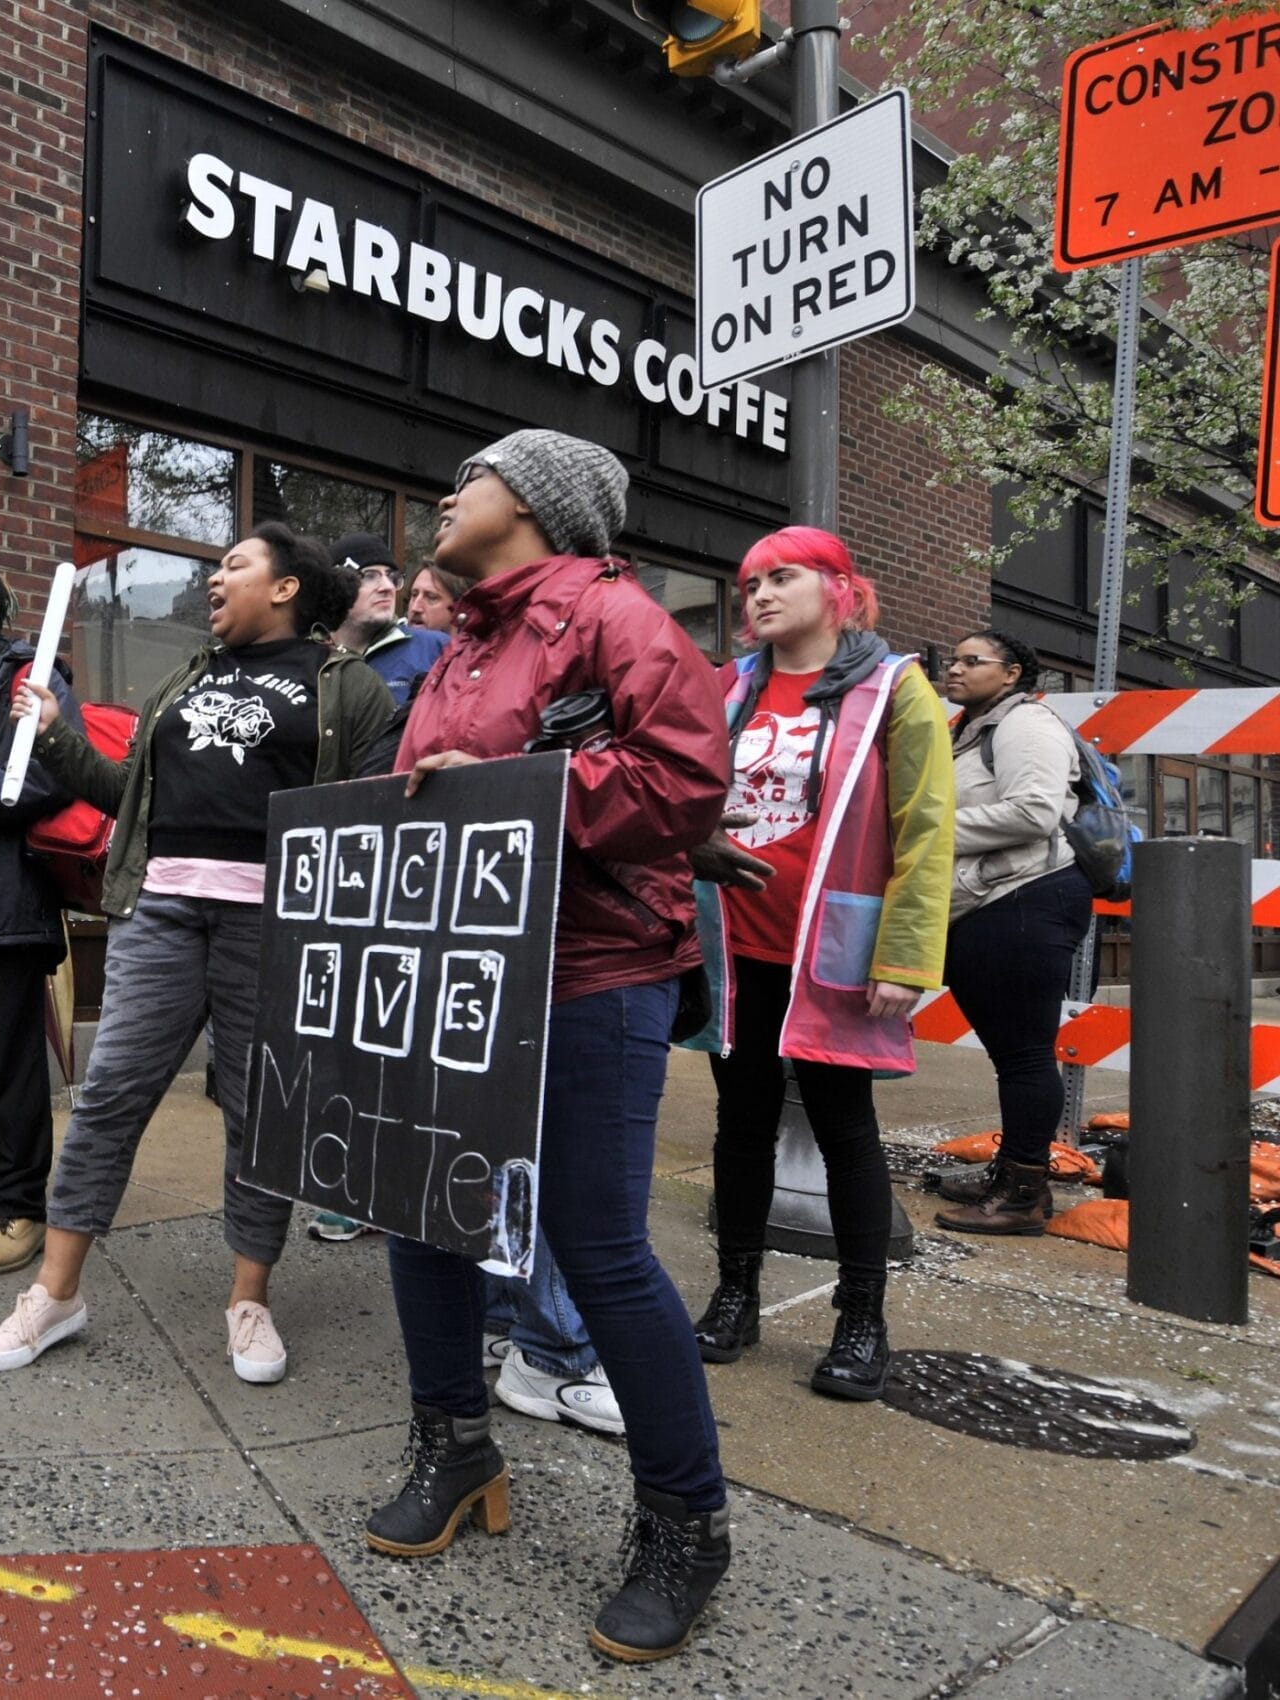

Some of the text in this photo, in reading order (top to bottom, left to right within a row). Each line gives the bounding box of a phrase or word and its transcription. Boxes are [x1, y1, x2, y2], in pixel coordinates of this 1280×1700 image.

[1203, 91, 1280, 146] ZO
[764, 156, 830, 220] NO
[1095, 192, 1119, 227] 7
[1153, 166, 1222, 214] AM
[185, 152, 620, 386] STARBUCKS
[732, 194, 869, 288] TURN
[711, 249, 896, 353] ON RED
